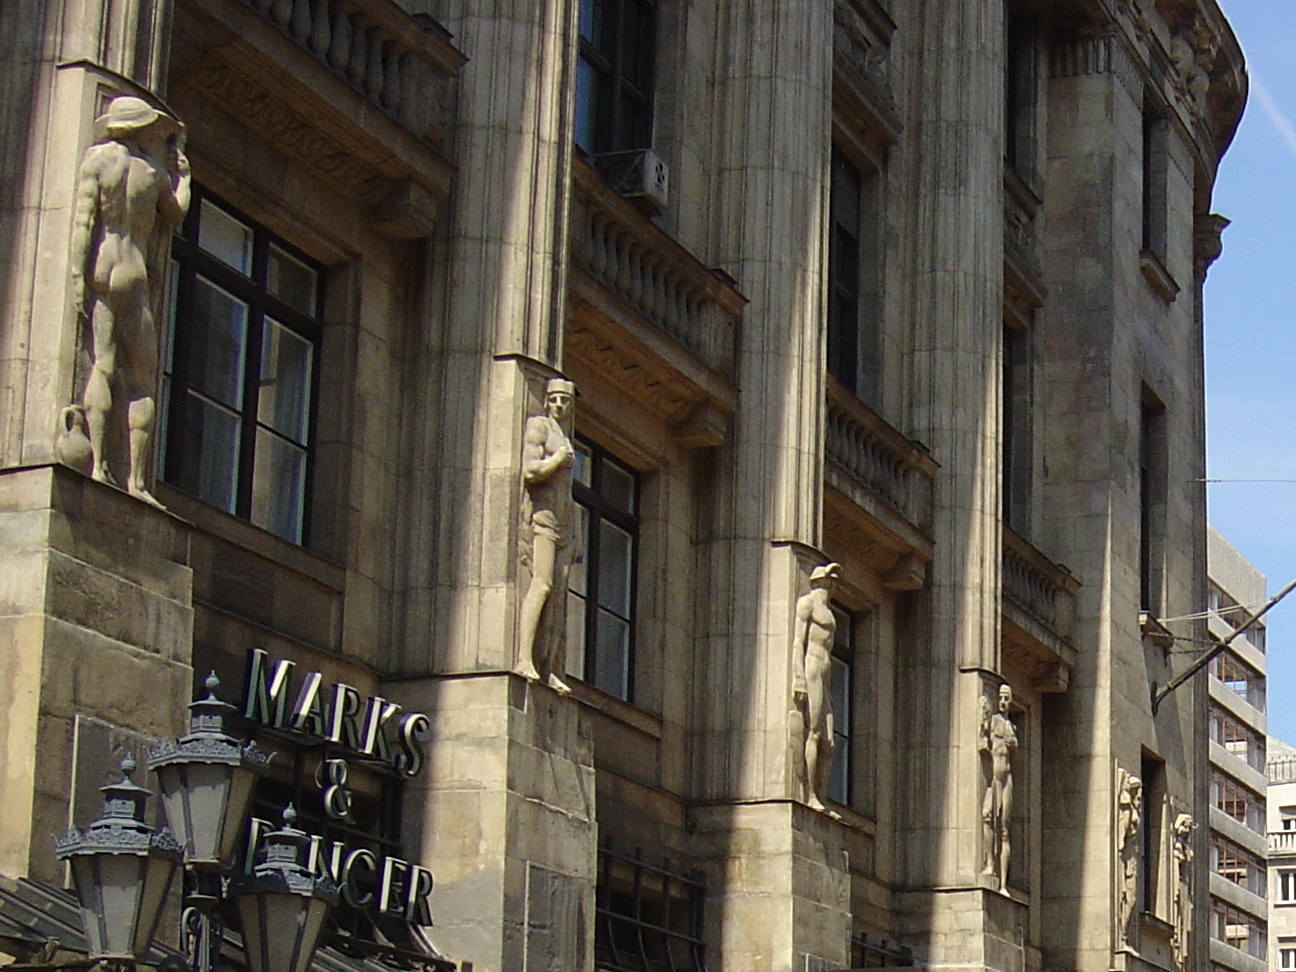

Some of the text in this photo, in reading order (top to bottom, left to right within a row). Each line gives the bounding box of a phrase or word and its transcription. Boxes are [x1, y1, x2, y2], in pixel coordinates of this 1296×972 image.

[243, 648, 431, 778] MARKS
[322, 758, 356, 825] &
[230, 815, 435, 929] PNCER
